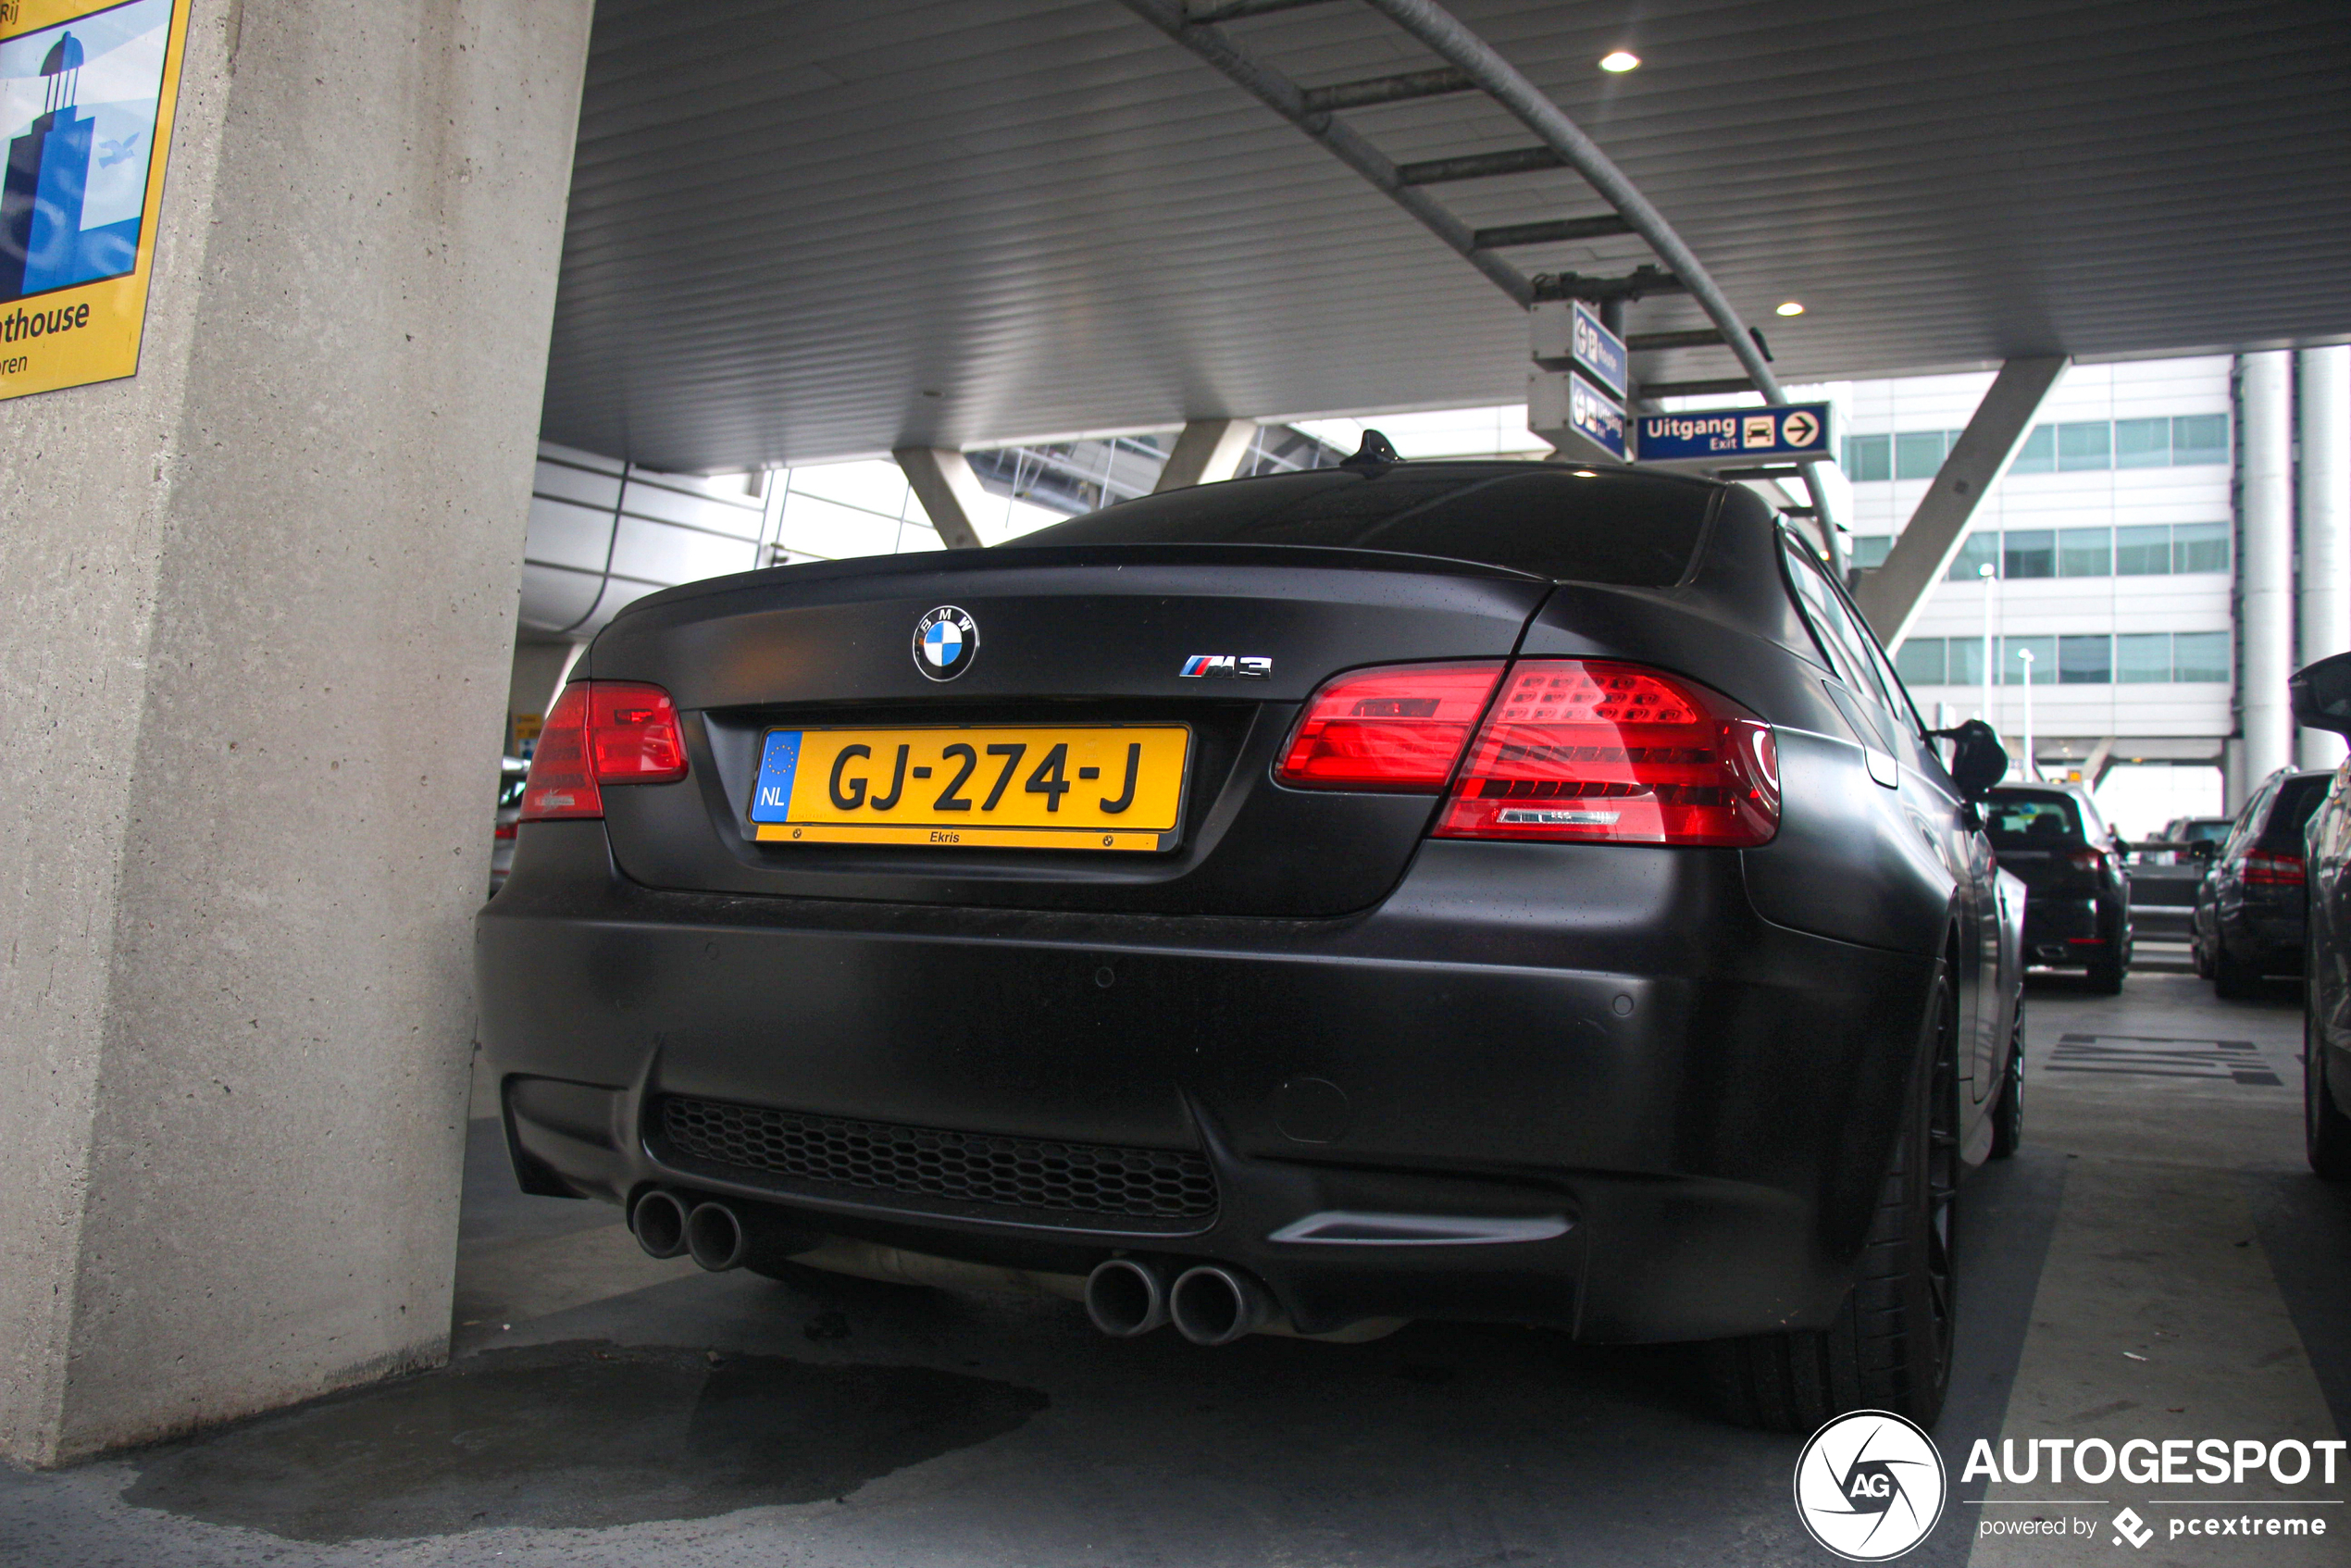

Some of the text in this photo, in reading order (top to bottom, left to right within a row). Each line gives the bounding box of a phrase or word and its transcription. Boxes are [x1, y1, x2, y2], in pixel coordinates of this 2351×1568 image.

[0, 355, 28, 375] ren
[1648, 417, 1736, 441] Uitgang
[1710, 437, 1738, 451] Exit
[921, 608, 972, 632] BMW
[1197, 655, 1273, 679] M3
[829, 743, 1140, 814] GJ-274-J
[761, 788, 784, 805] NL
[929, 831, 960, 843] Ekris
